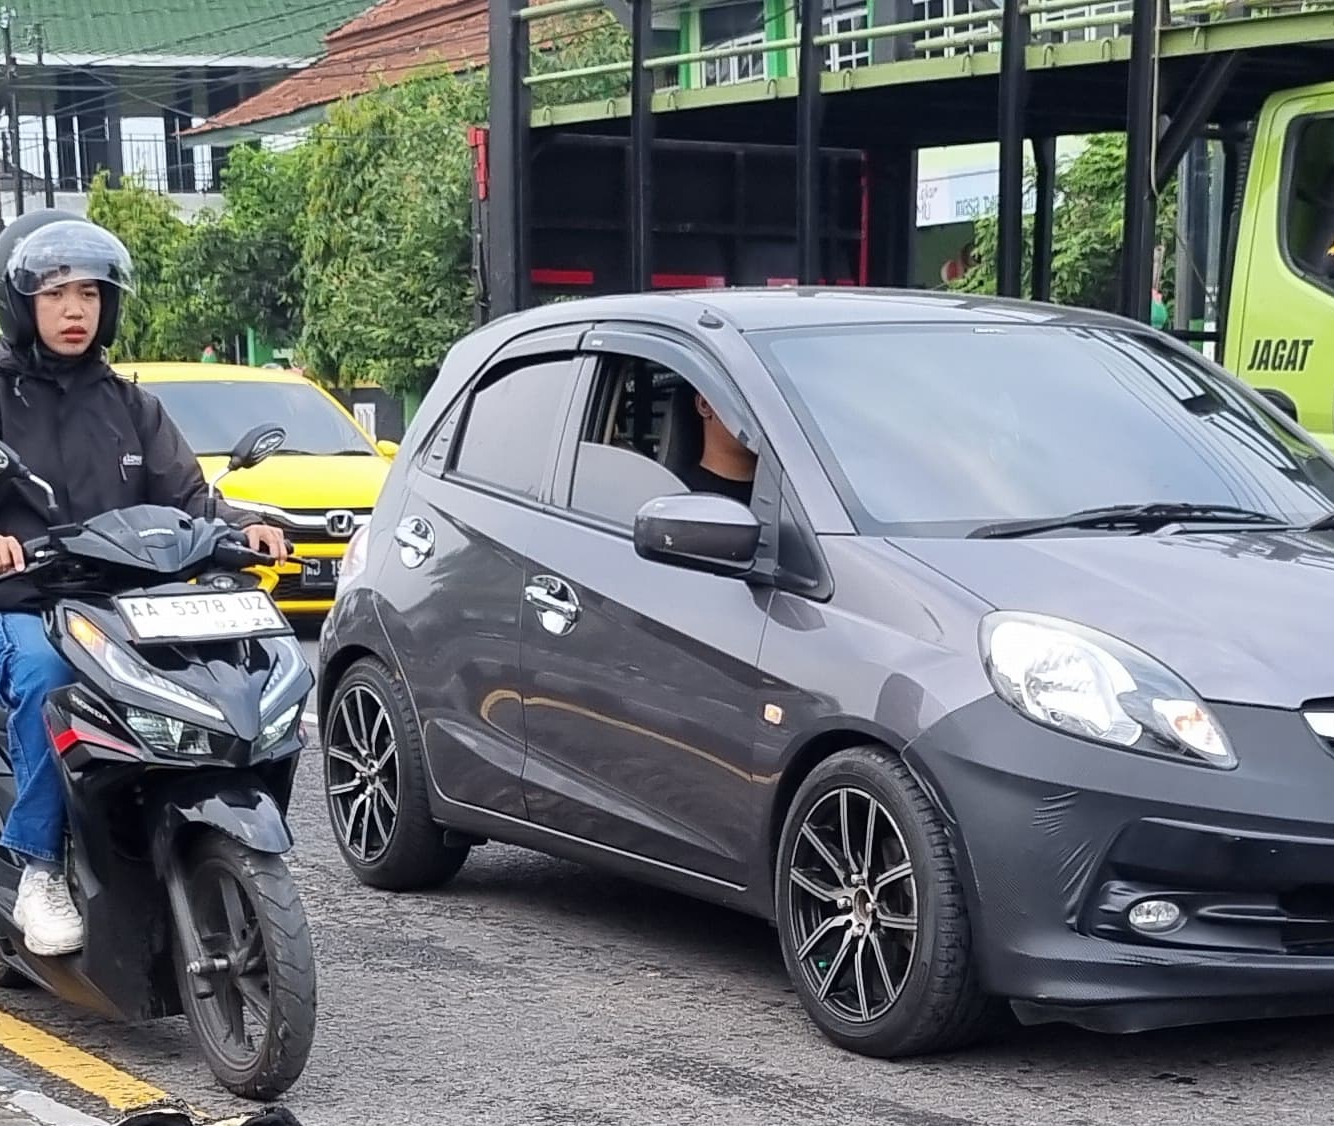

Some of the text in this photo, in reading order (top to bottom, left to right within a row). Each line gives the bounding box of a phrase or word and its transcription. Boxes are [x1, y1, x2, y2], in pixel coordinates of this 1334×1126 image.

[1247, 338, 1314, 372] JAGAT
[129, 595, 268, 618] AA 5378 UZ
